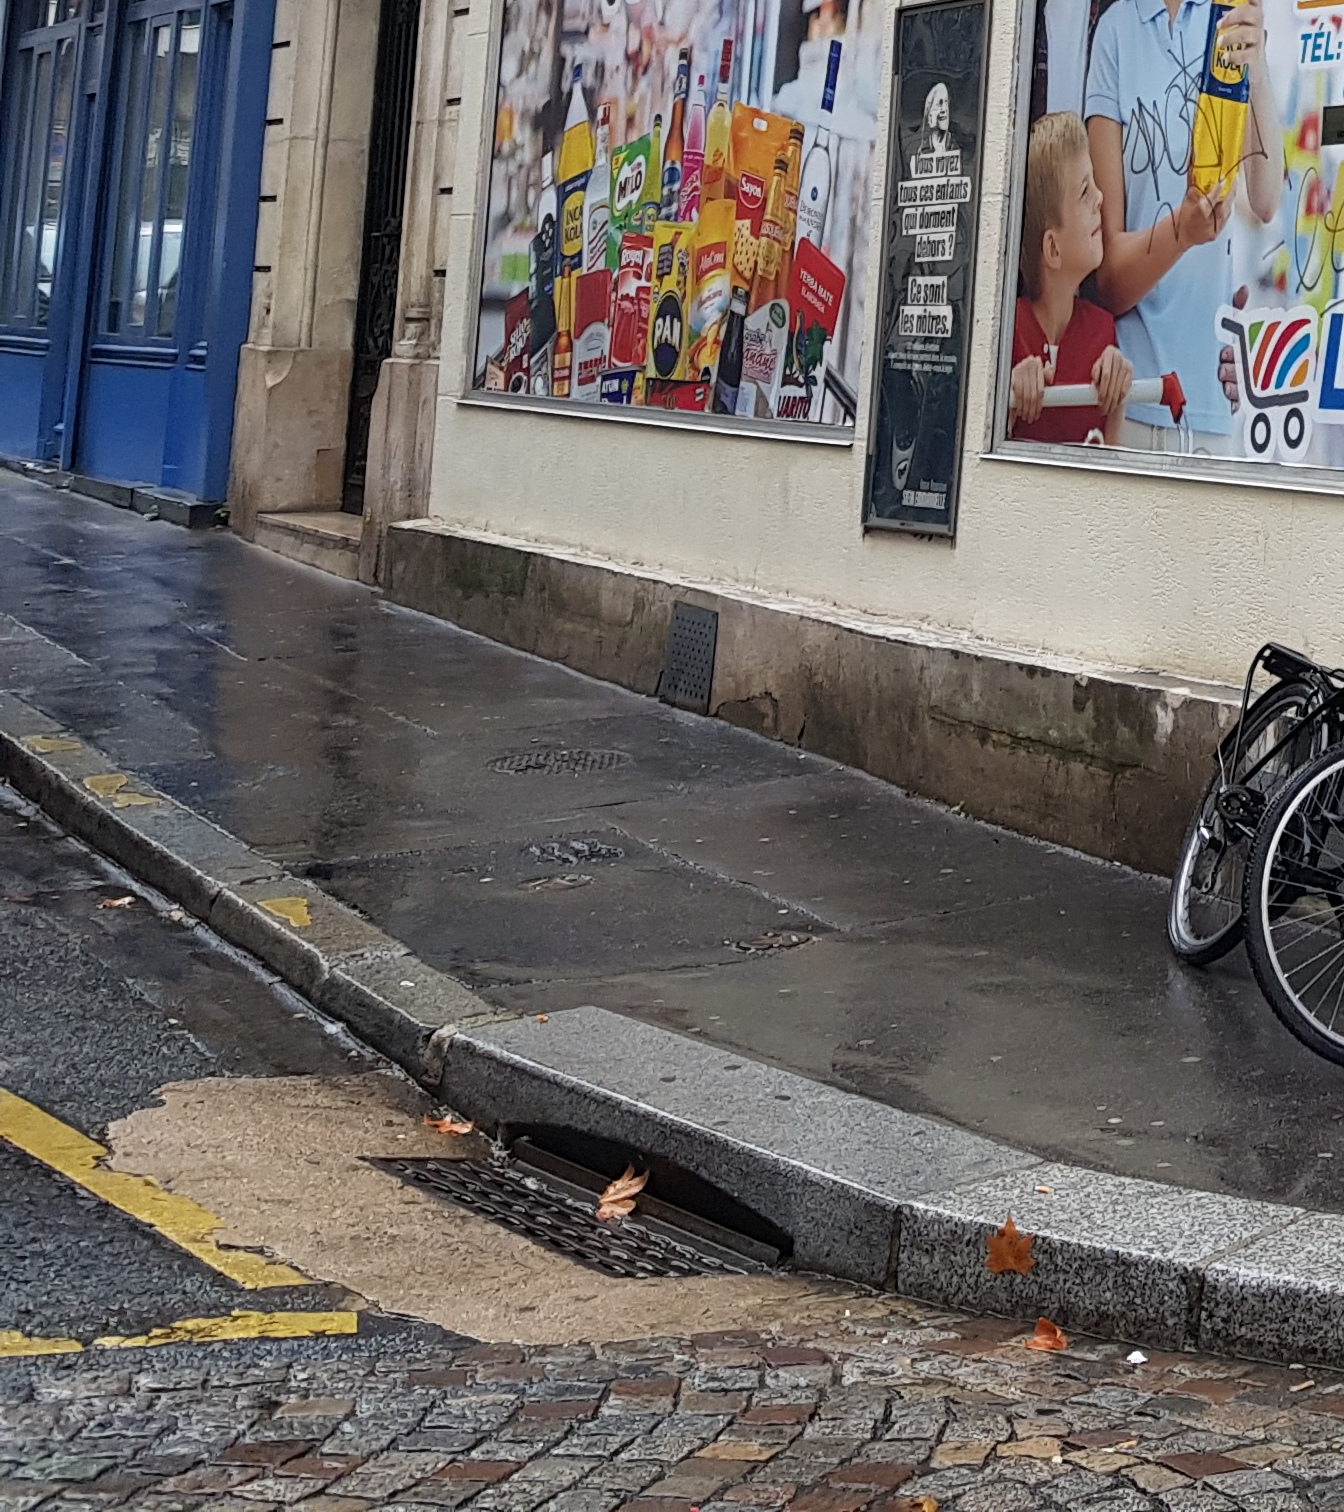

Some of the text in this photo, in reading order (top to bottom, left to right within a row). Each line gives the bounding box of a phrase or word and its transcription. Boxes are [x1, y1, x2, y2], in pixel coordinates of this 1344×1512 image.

[1300, 23, 1343, 63] TÉL:
[914, 153, 959, 176] Vous voyez
[899, 182, 968, 204] tous ces enfants
[904, 208, 956, 231] qui dorment
[916, 238, 946, 258] dehors
[910, 278, 945, 304] Ce sont
[900, 308, 950, 335] les nôtres.
[653, 315, 681, 353] PAN
